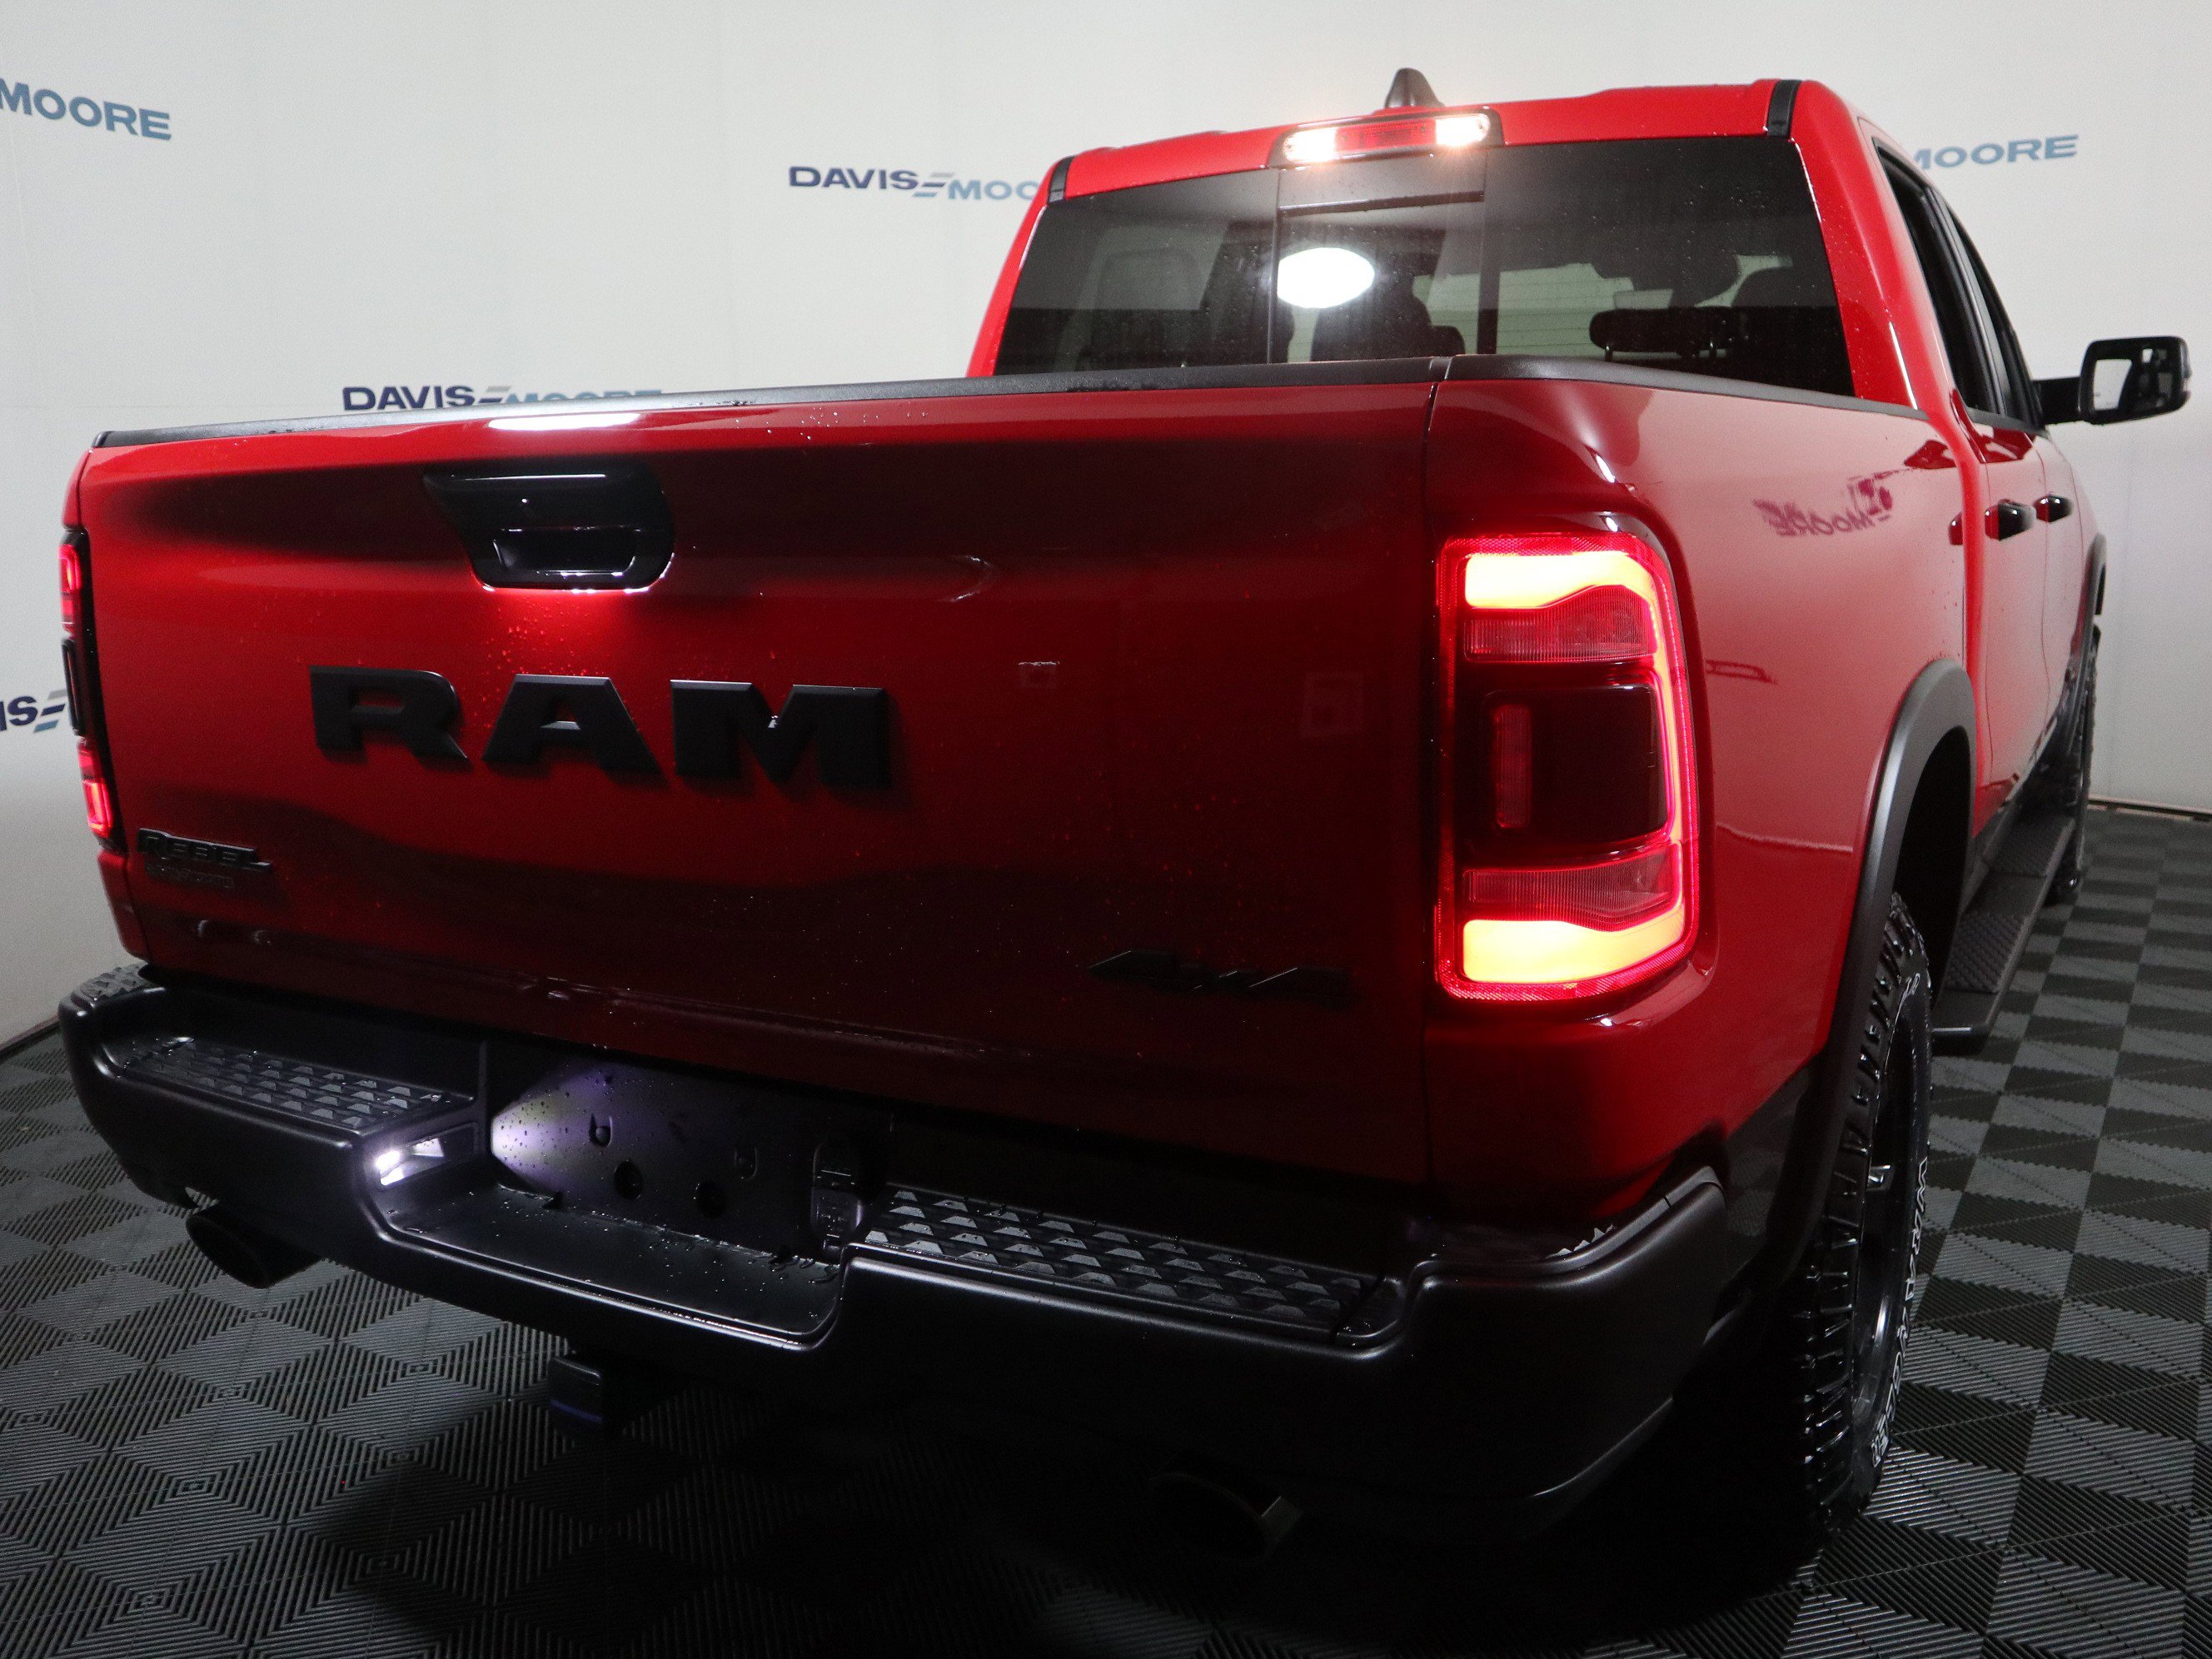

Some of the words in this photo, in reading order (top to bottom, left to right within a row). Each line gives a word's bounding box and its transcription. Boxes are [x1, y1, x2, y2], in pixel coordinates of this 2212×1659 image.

[0, 78, 172, 141] MOORE
[788, 166, 919, 190] DAVIS
[342, 385, 475, 411] DAVIS
[309, 665, 889, 789] RAM
